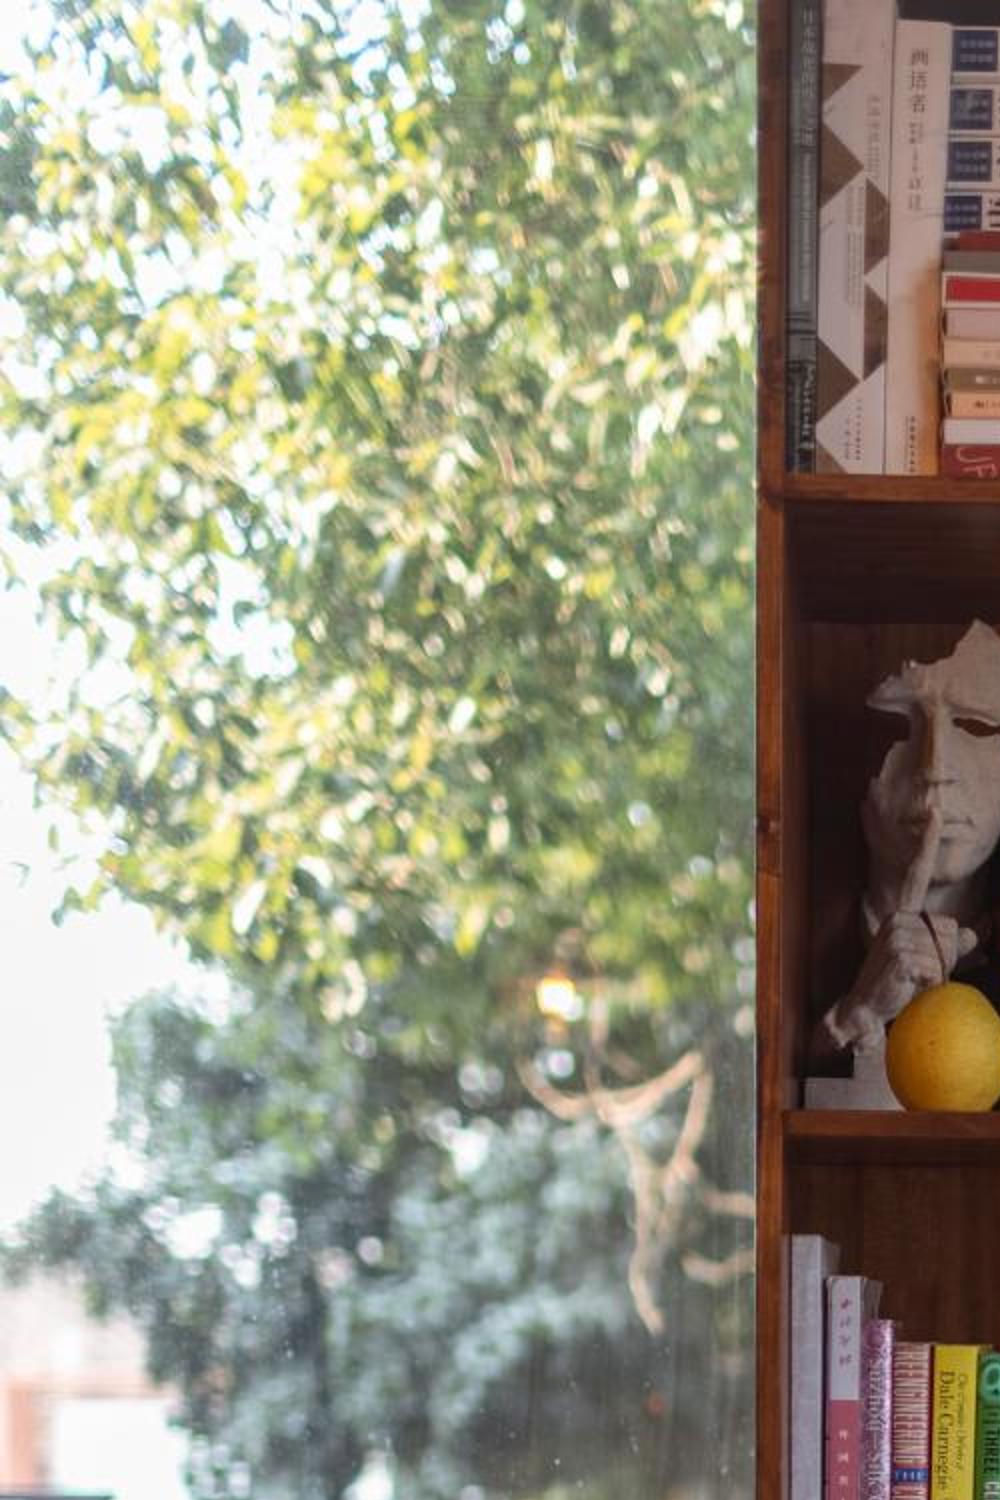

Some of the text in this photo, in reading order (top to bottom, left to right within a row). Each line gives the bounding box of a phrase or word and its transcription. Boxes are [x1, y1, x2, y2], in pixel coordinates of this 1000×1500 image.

[892, 1349, 928, 1464] REENGINEERING
[936, 1370, 955, 1490] Dale Carnegie
[983, 1429, 1000, 1474] THREE
